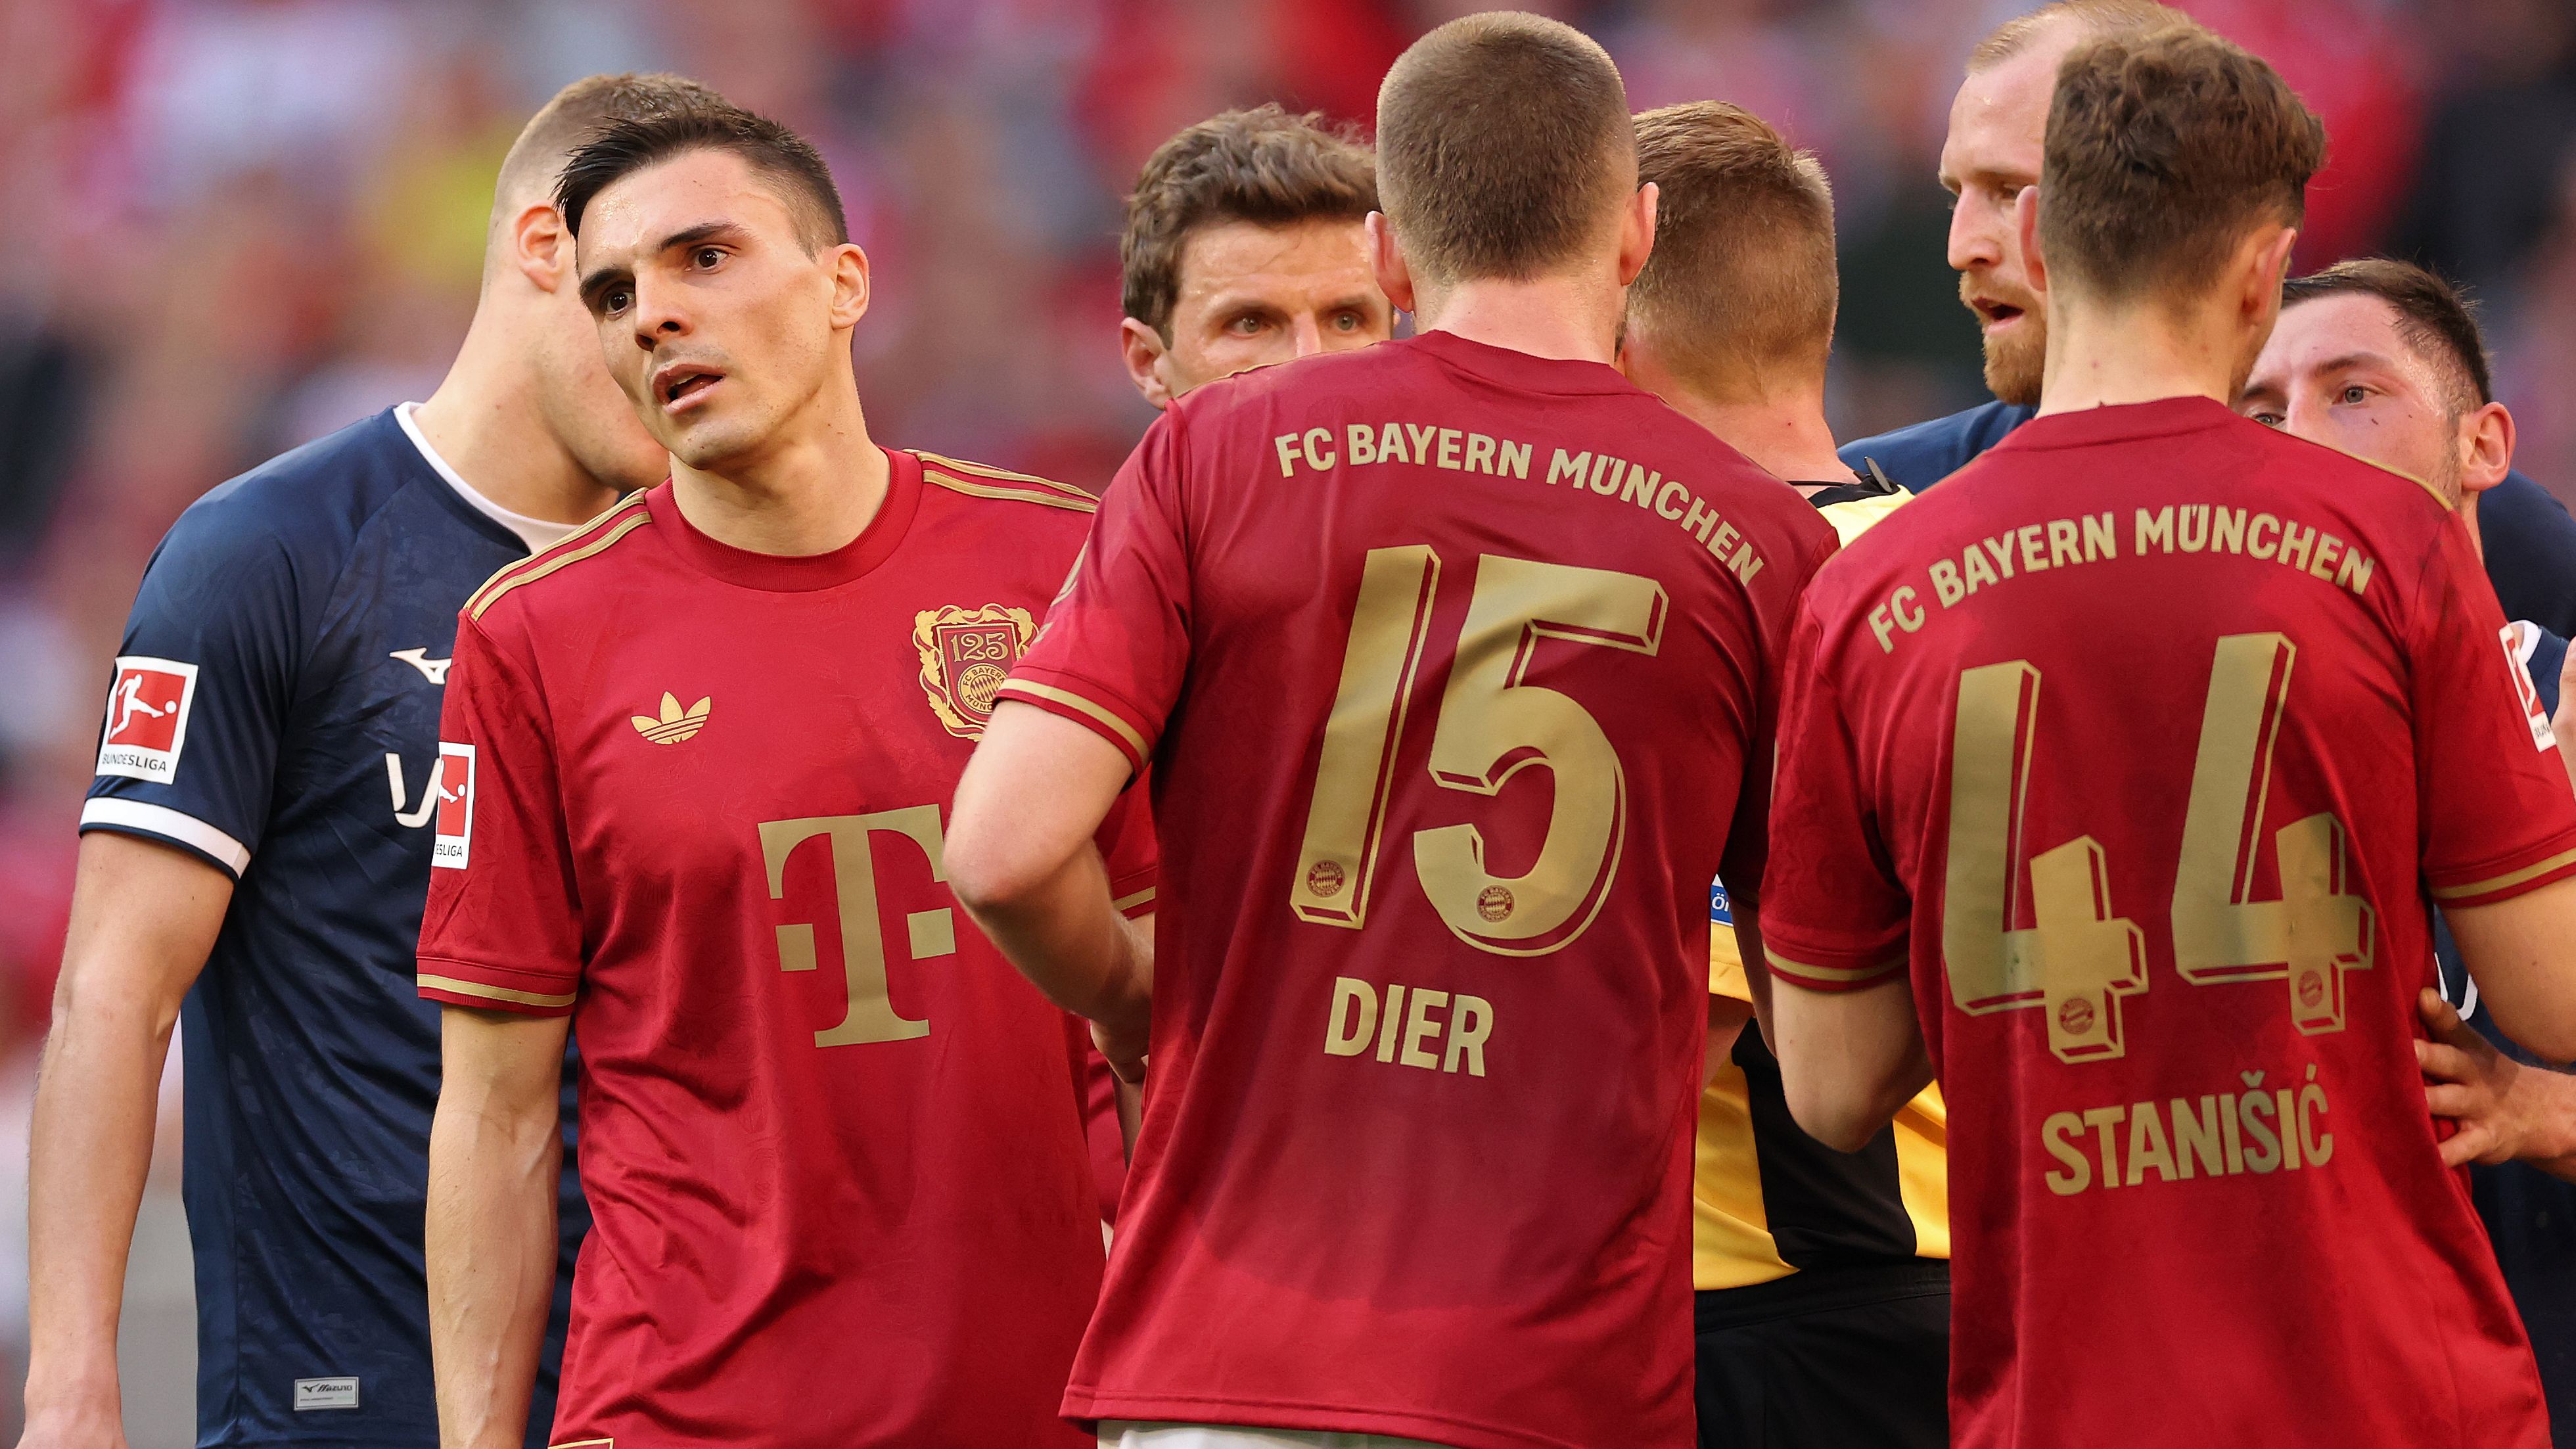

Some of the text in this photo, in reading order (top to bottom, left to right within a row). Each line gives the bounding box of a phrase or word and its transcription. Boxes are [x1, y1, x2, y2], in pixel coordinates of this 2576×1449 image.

[1274, 423, 1766, 587] FC BAYERN MÜNCHEN
[950, 632, 1009, 662] 125
[1867, 503, 2375, 655] FC BAYERN MÜNCHEN
[963, 675, 972, 686] FC
[1290, 544, 1669, 957] 15
[103, 753, 167, 772] BUNDESLIGA
[1943, 631, 2375, 1065] 44
[758, 804, 948, 1047] T
[1323, 977, 1494, 1078] DIER
[2042, 1063, 2334, 1196] STANIŠIĆ
